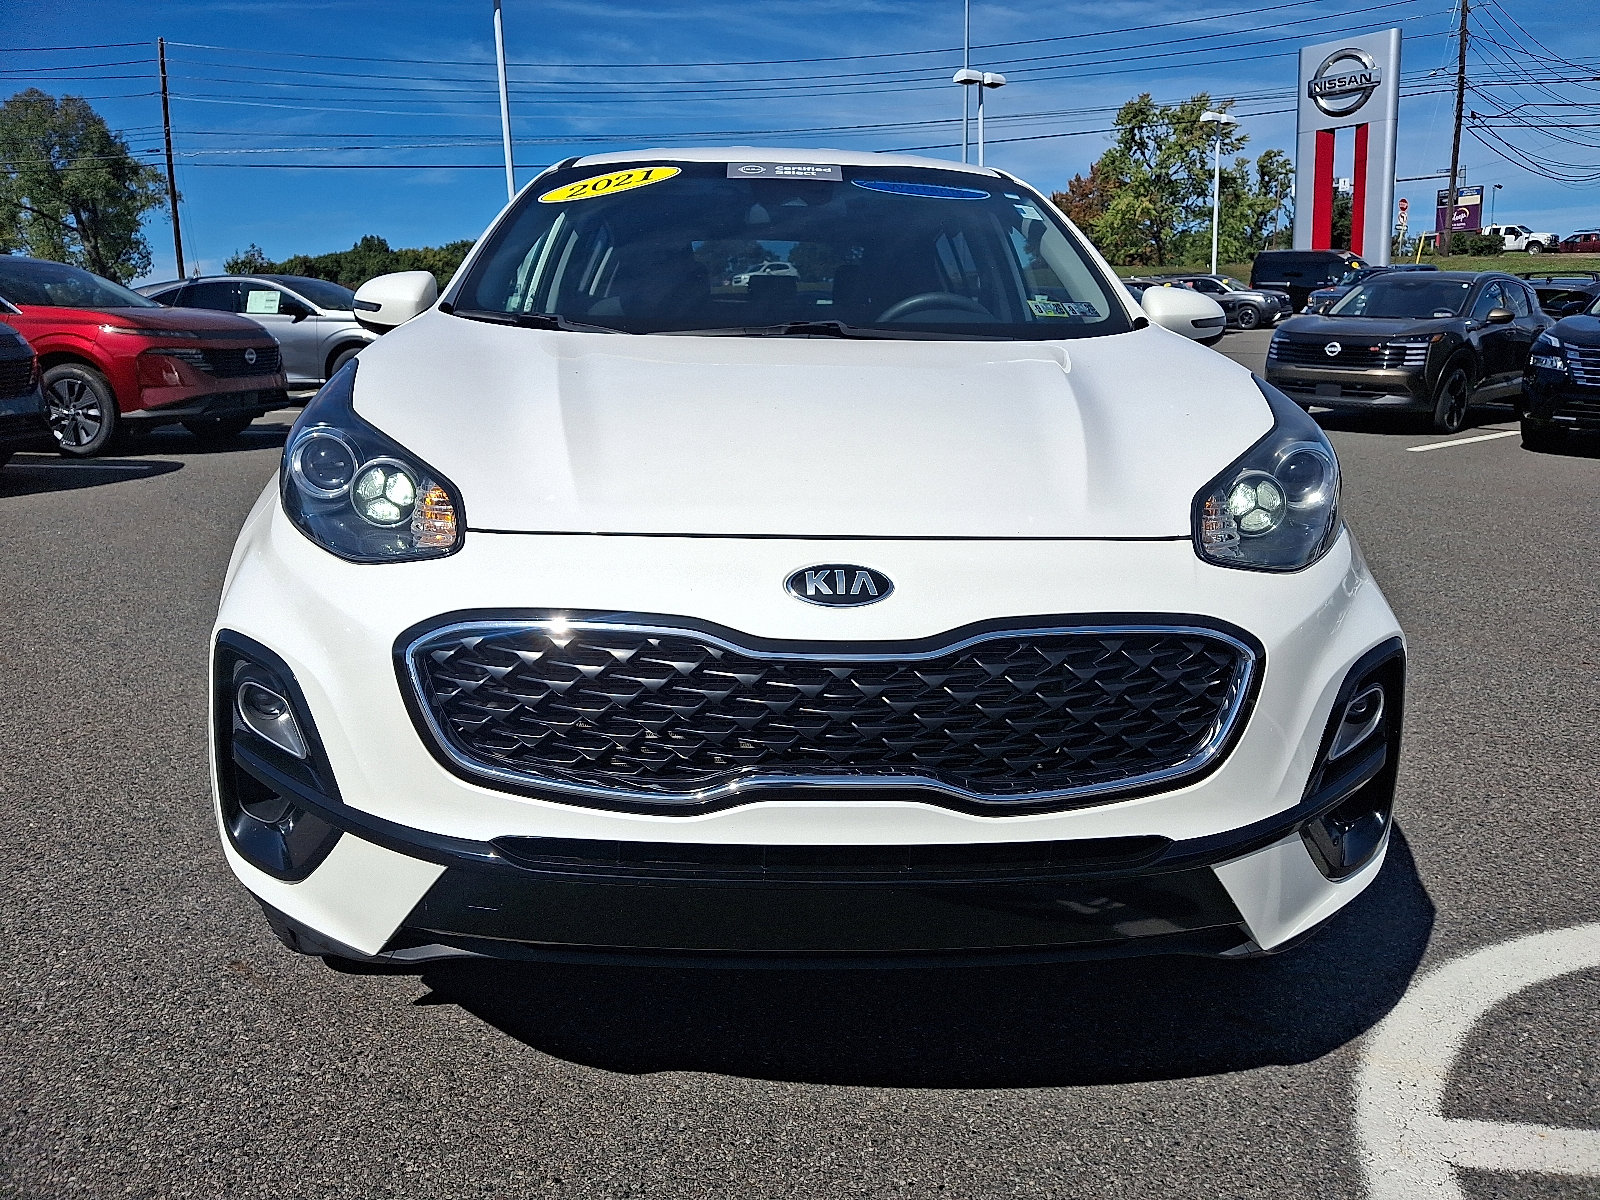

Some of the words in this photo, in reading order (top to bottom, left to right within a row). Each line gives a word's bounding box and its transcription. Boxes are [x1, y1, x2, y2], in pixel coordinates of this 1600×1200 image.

[1313, 72, 1372, 93] NISSAN
[774, 165, 832, 173] Certified
[565, 169, 655, 198] 2021
[804, 569, 879, 596] KIA
